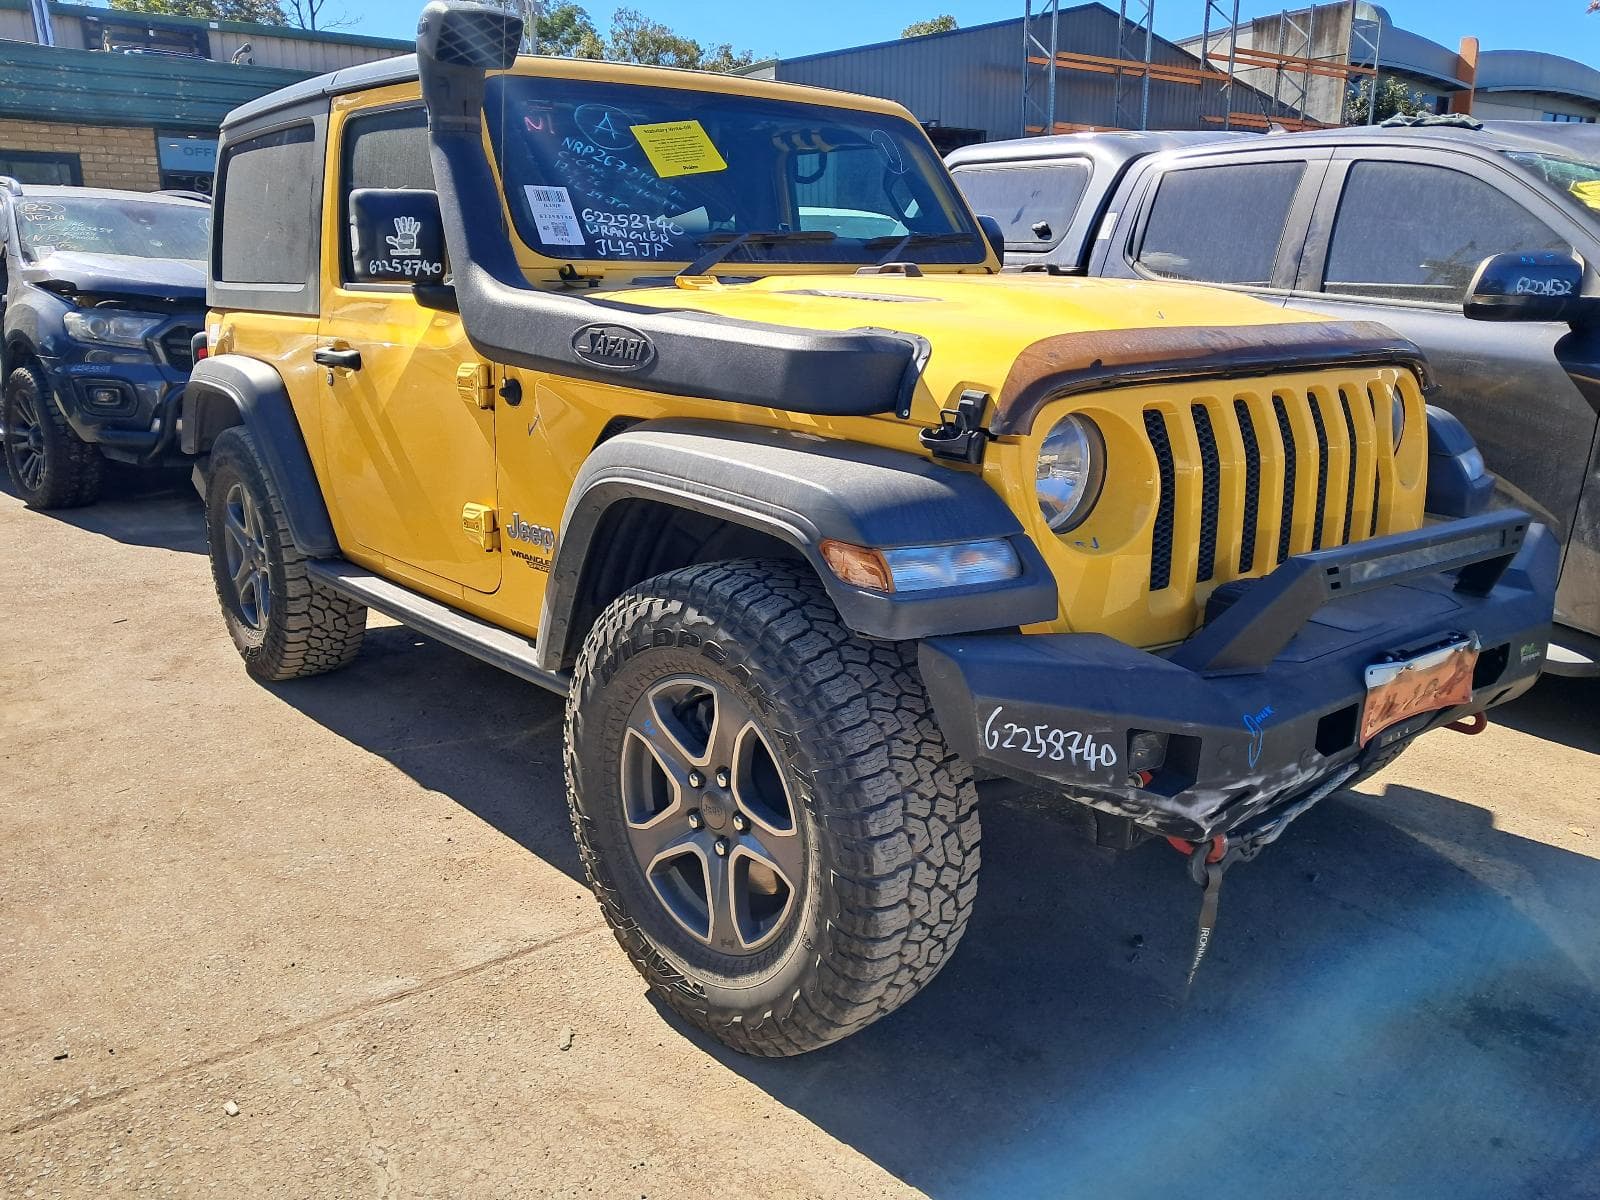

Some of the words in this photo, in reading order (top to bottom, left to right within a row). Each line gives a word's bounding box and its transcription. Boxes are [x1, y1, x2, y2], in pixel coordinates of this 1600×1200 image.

[594, 111, 622, 141] A
[183, 146, 216, 157] OFF
[585, 223, 674, 248] WRANGLER
[369, 258, 442, 277] 62258740
[577, 327, 648, 362] SAFARI
[505, 511, 555, 554] Jeep
[510, 548, 551, 566] WRANGLE
[984, 705, 1118, 772] 62258740
